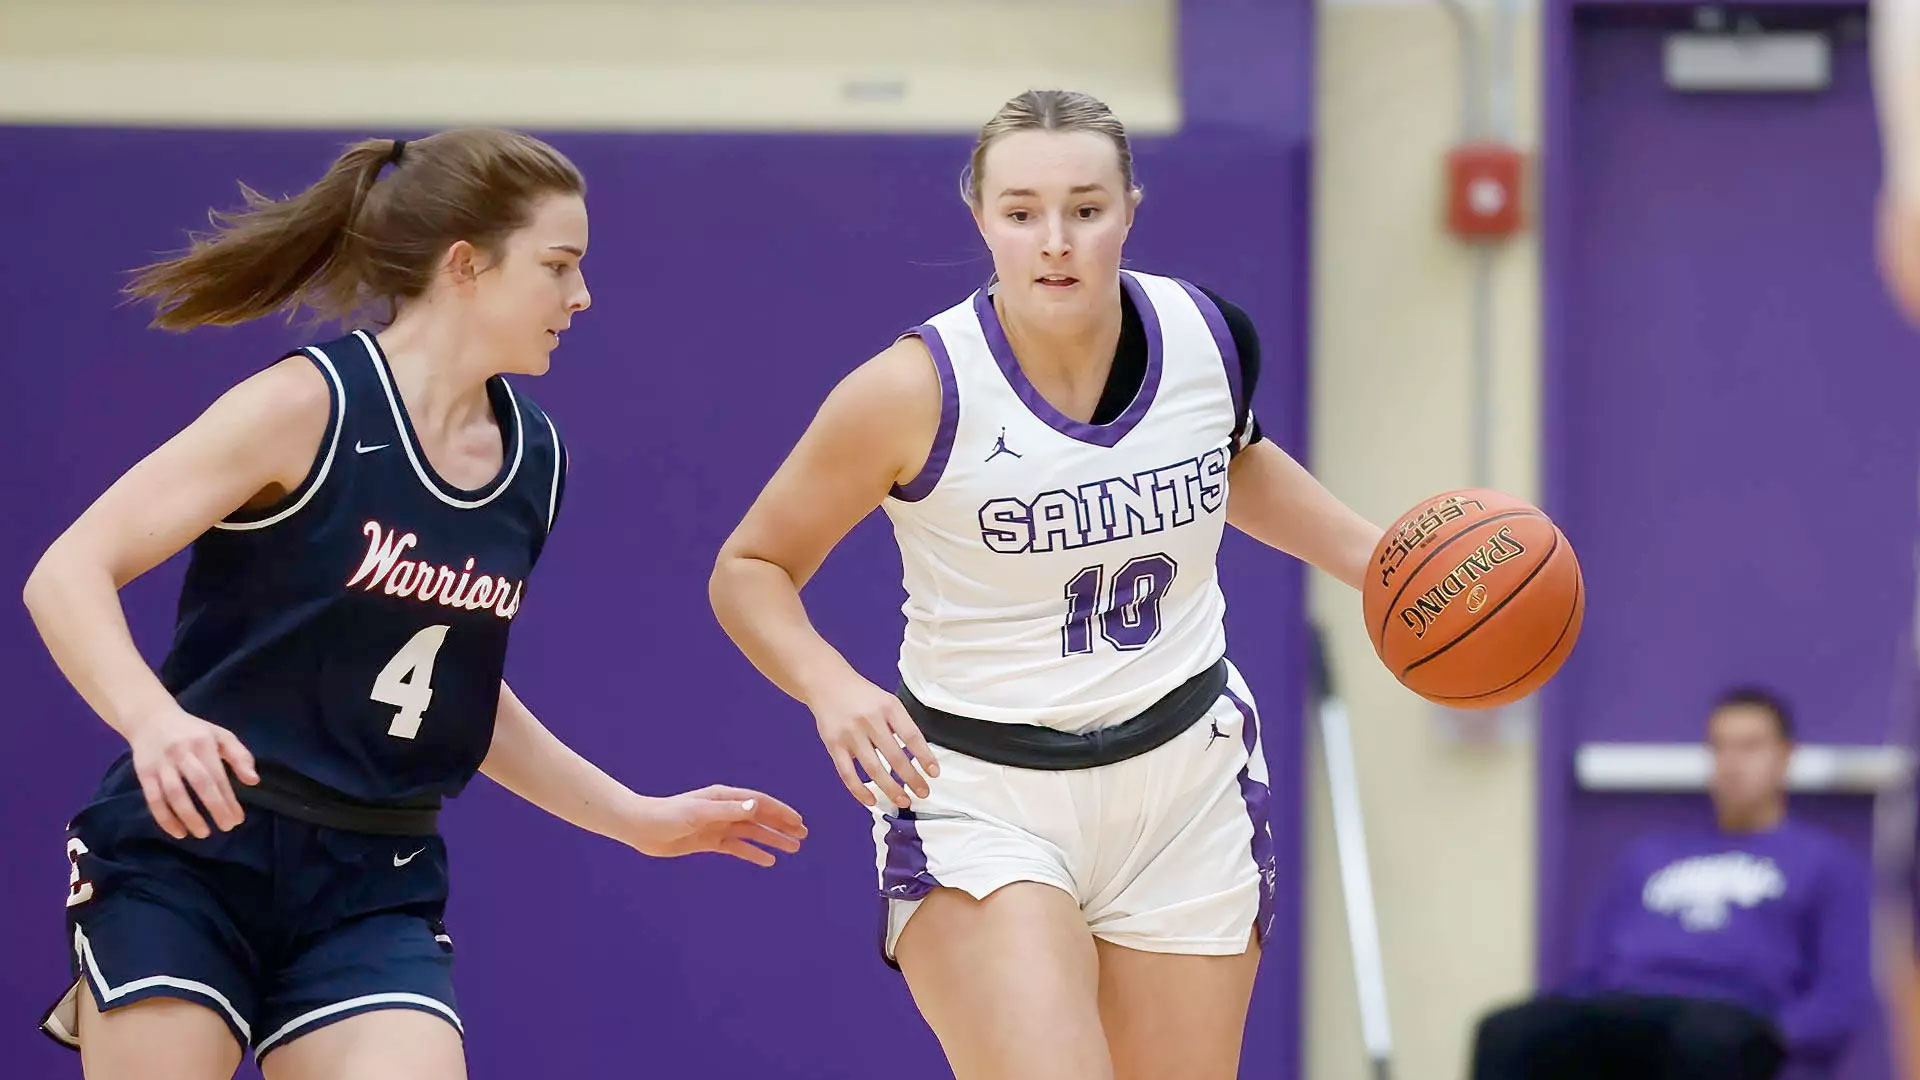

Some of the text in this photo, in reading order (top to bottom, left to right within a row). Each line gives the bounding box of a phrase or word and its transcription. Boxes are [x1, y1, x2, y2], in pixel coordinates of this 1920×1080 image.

[978, 447, 1226, 553] SAINTS
[1380, 499, 1485, 588] LEGACY
[1061, 552, 1177, 657] 10
[1400, 525, 1526, 639] SPALDING
[370, 624, 450, 740] 4
